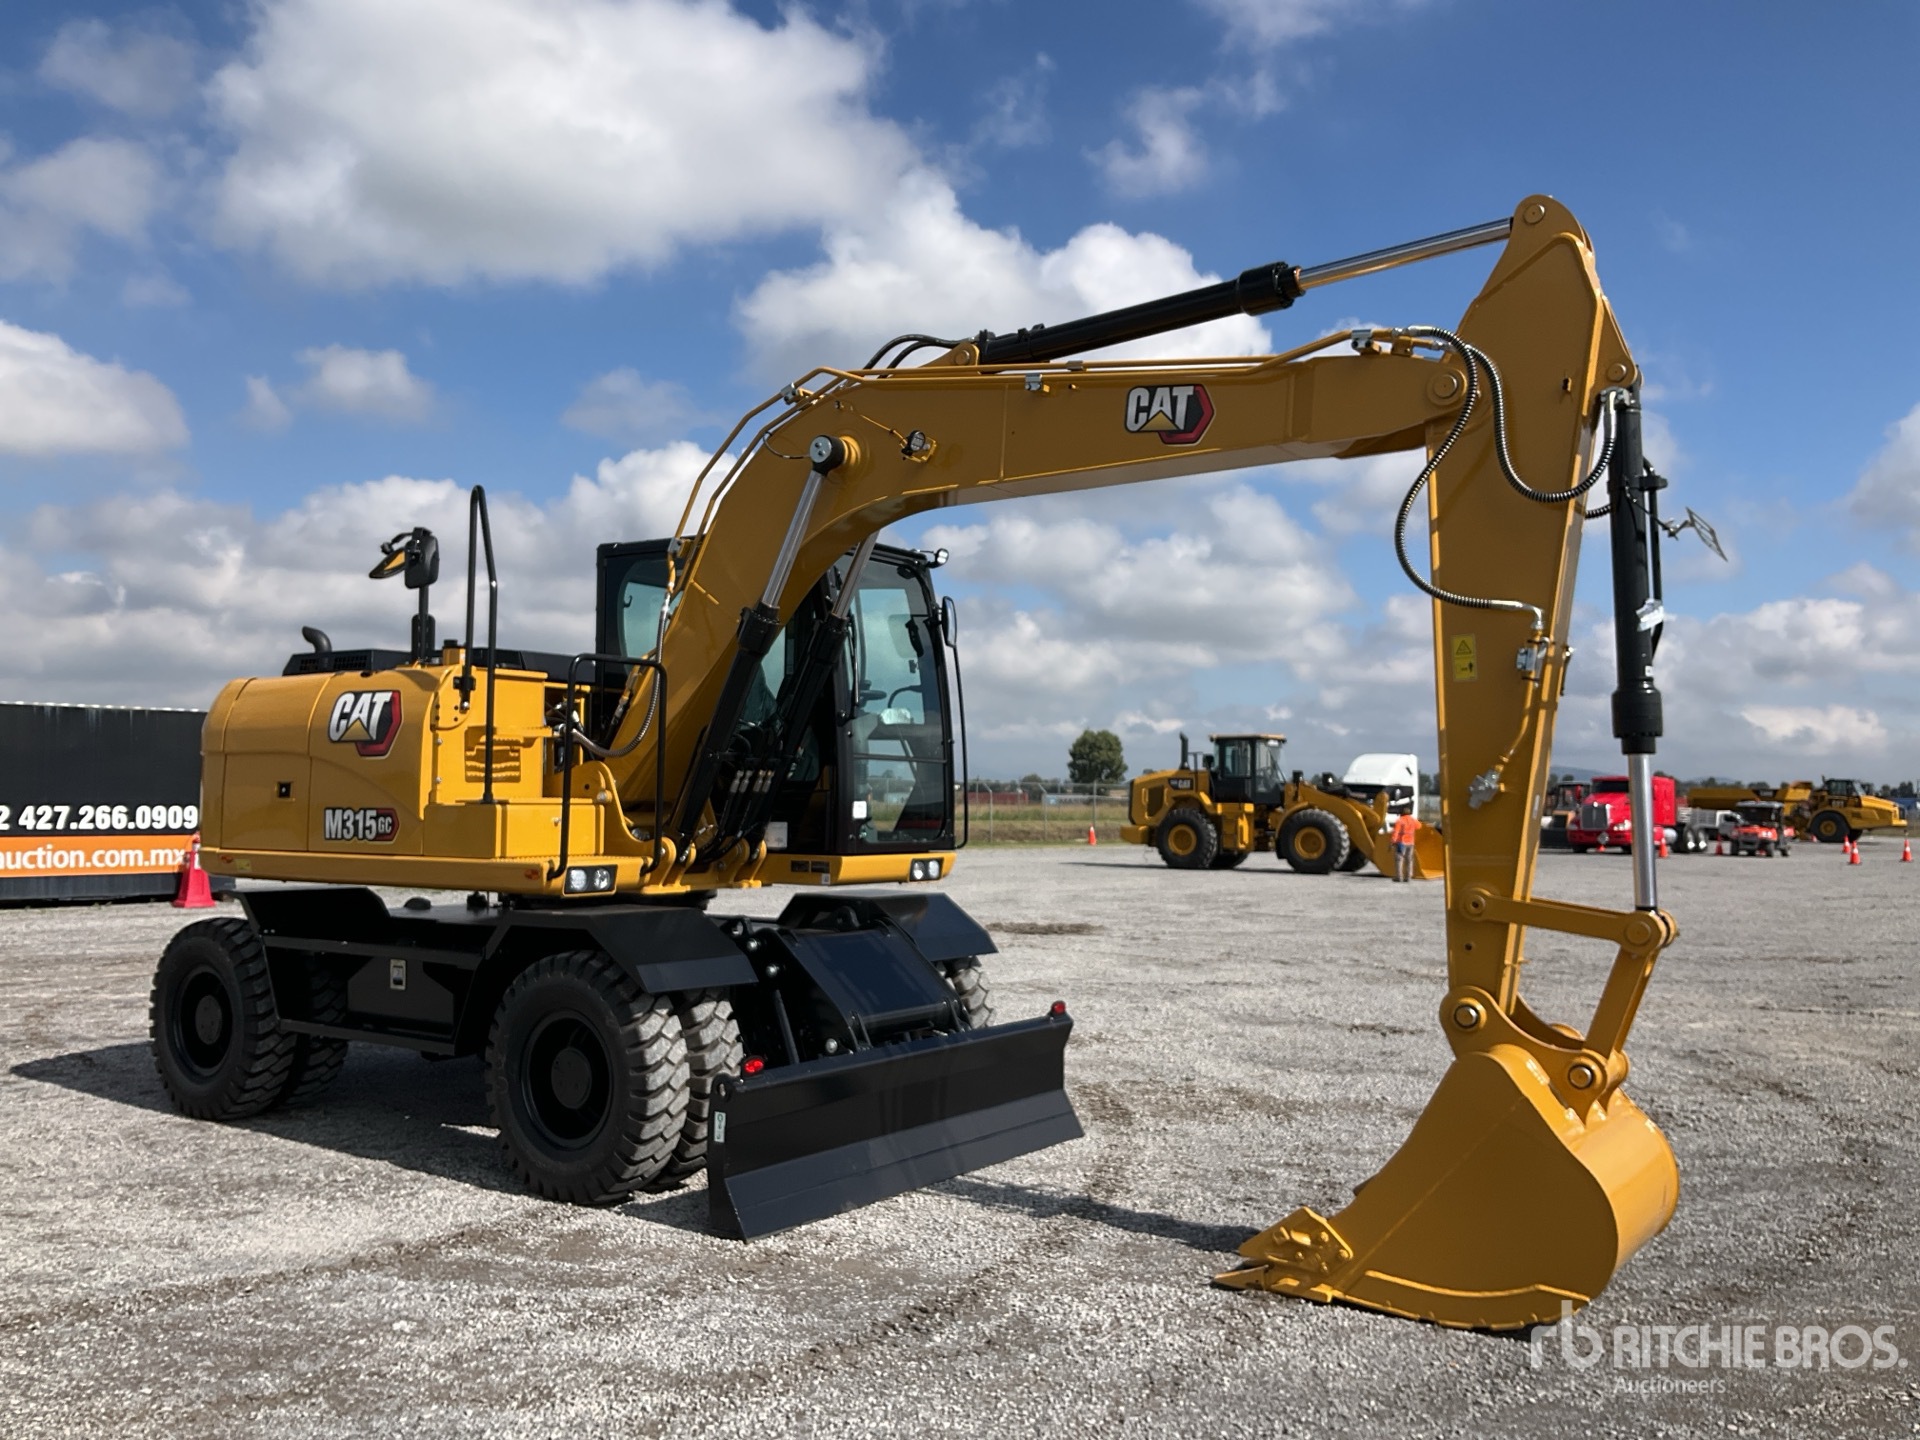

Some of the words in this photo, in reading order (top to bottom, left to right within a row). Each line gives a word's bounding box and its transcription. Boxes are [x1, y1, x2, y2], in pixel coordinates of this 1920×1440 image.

[1126, 385, 1195, 432] CAT
[329, 691, 393, 742] CAT
[18, 804, 199, 830] 427.266.0909
[324, 808, 377, 840] M315
[377, 815, 393, 834] GC
